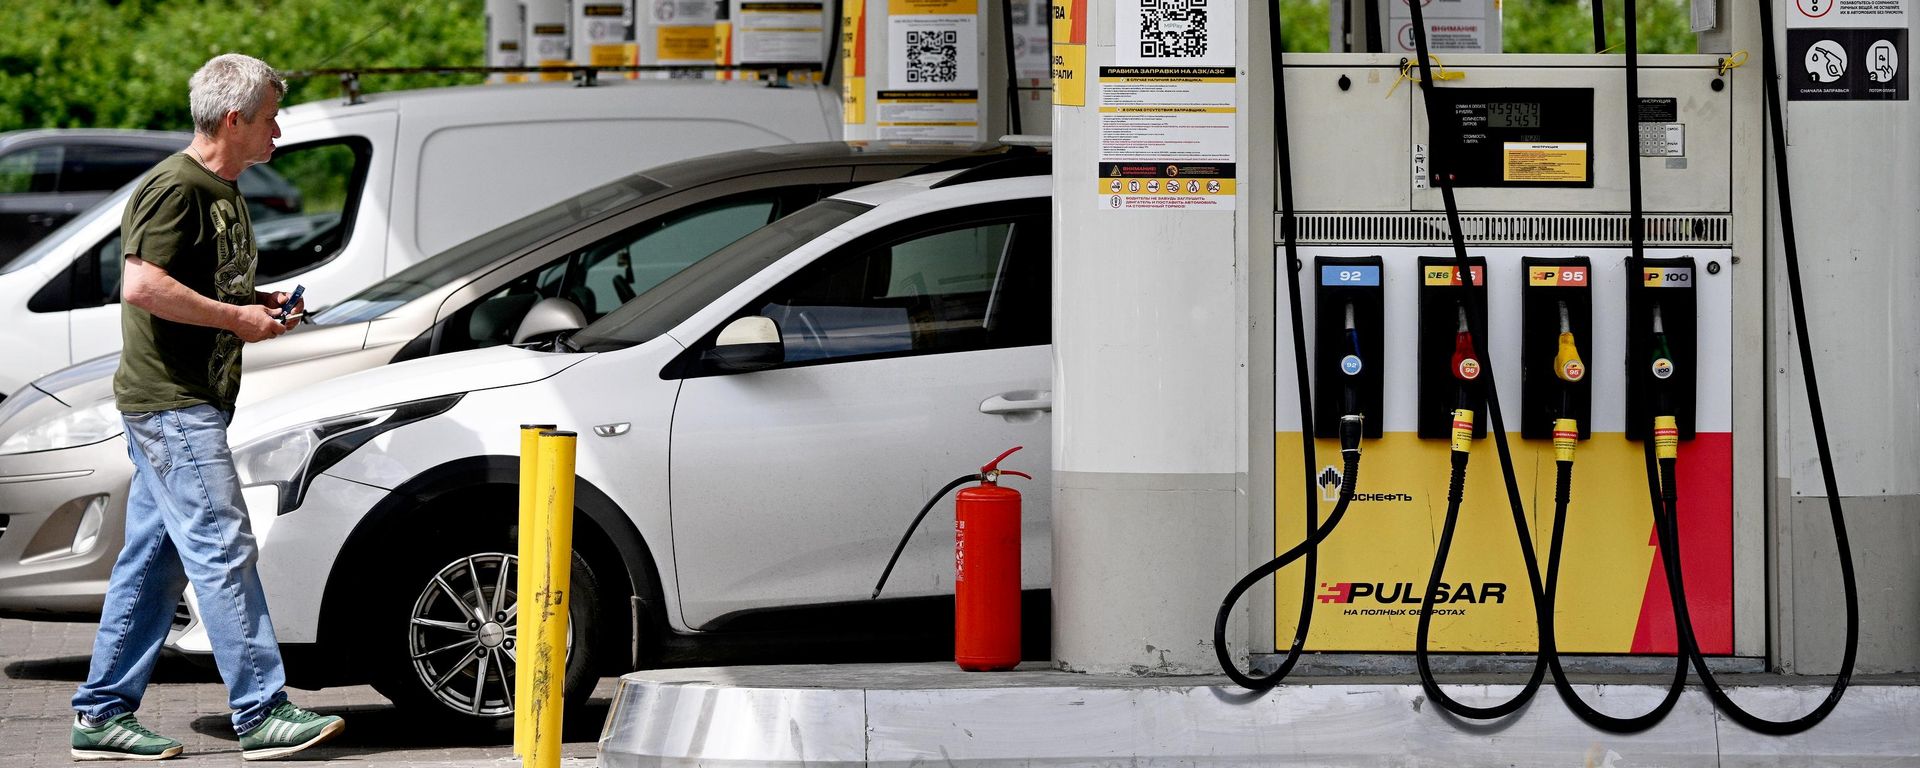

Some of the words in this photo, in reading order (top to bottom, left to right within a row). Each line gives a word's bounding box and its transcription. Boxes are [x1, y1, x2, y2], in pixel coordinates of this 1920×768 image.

[1340, 271, 1361, 281] 92
[1562, 272, 1583, 281] 95
[1665, 273, 1688, 281] 100
[1347, 583, 1507, 603] PULSAR
